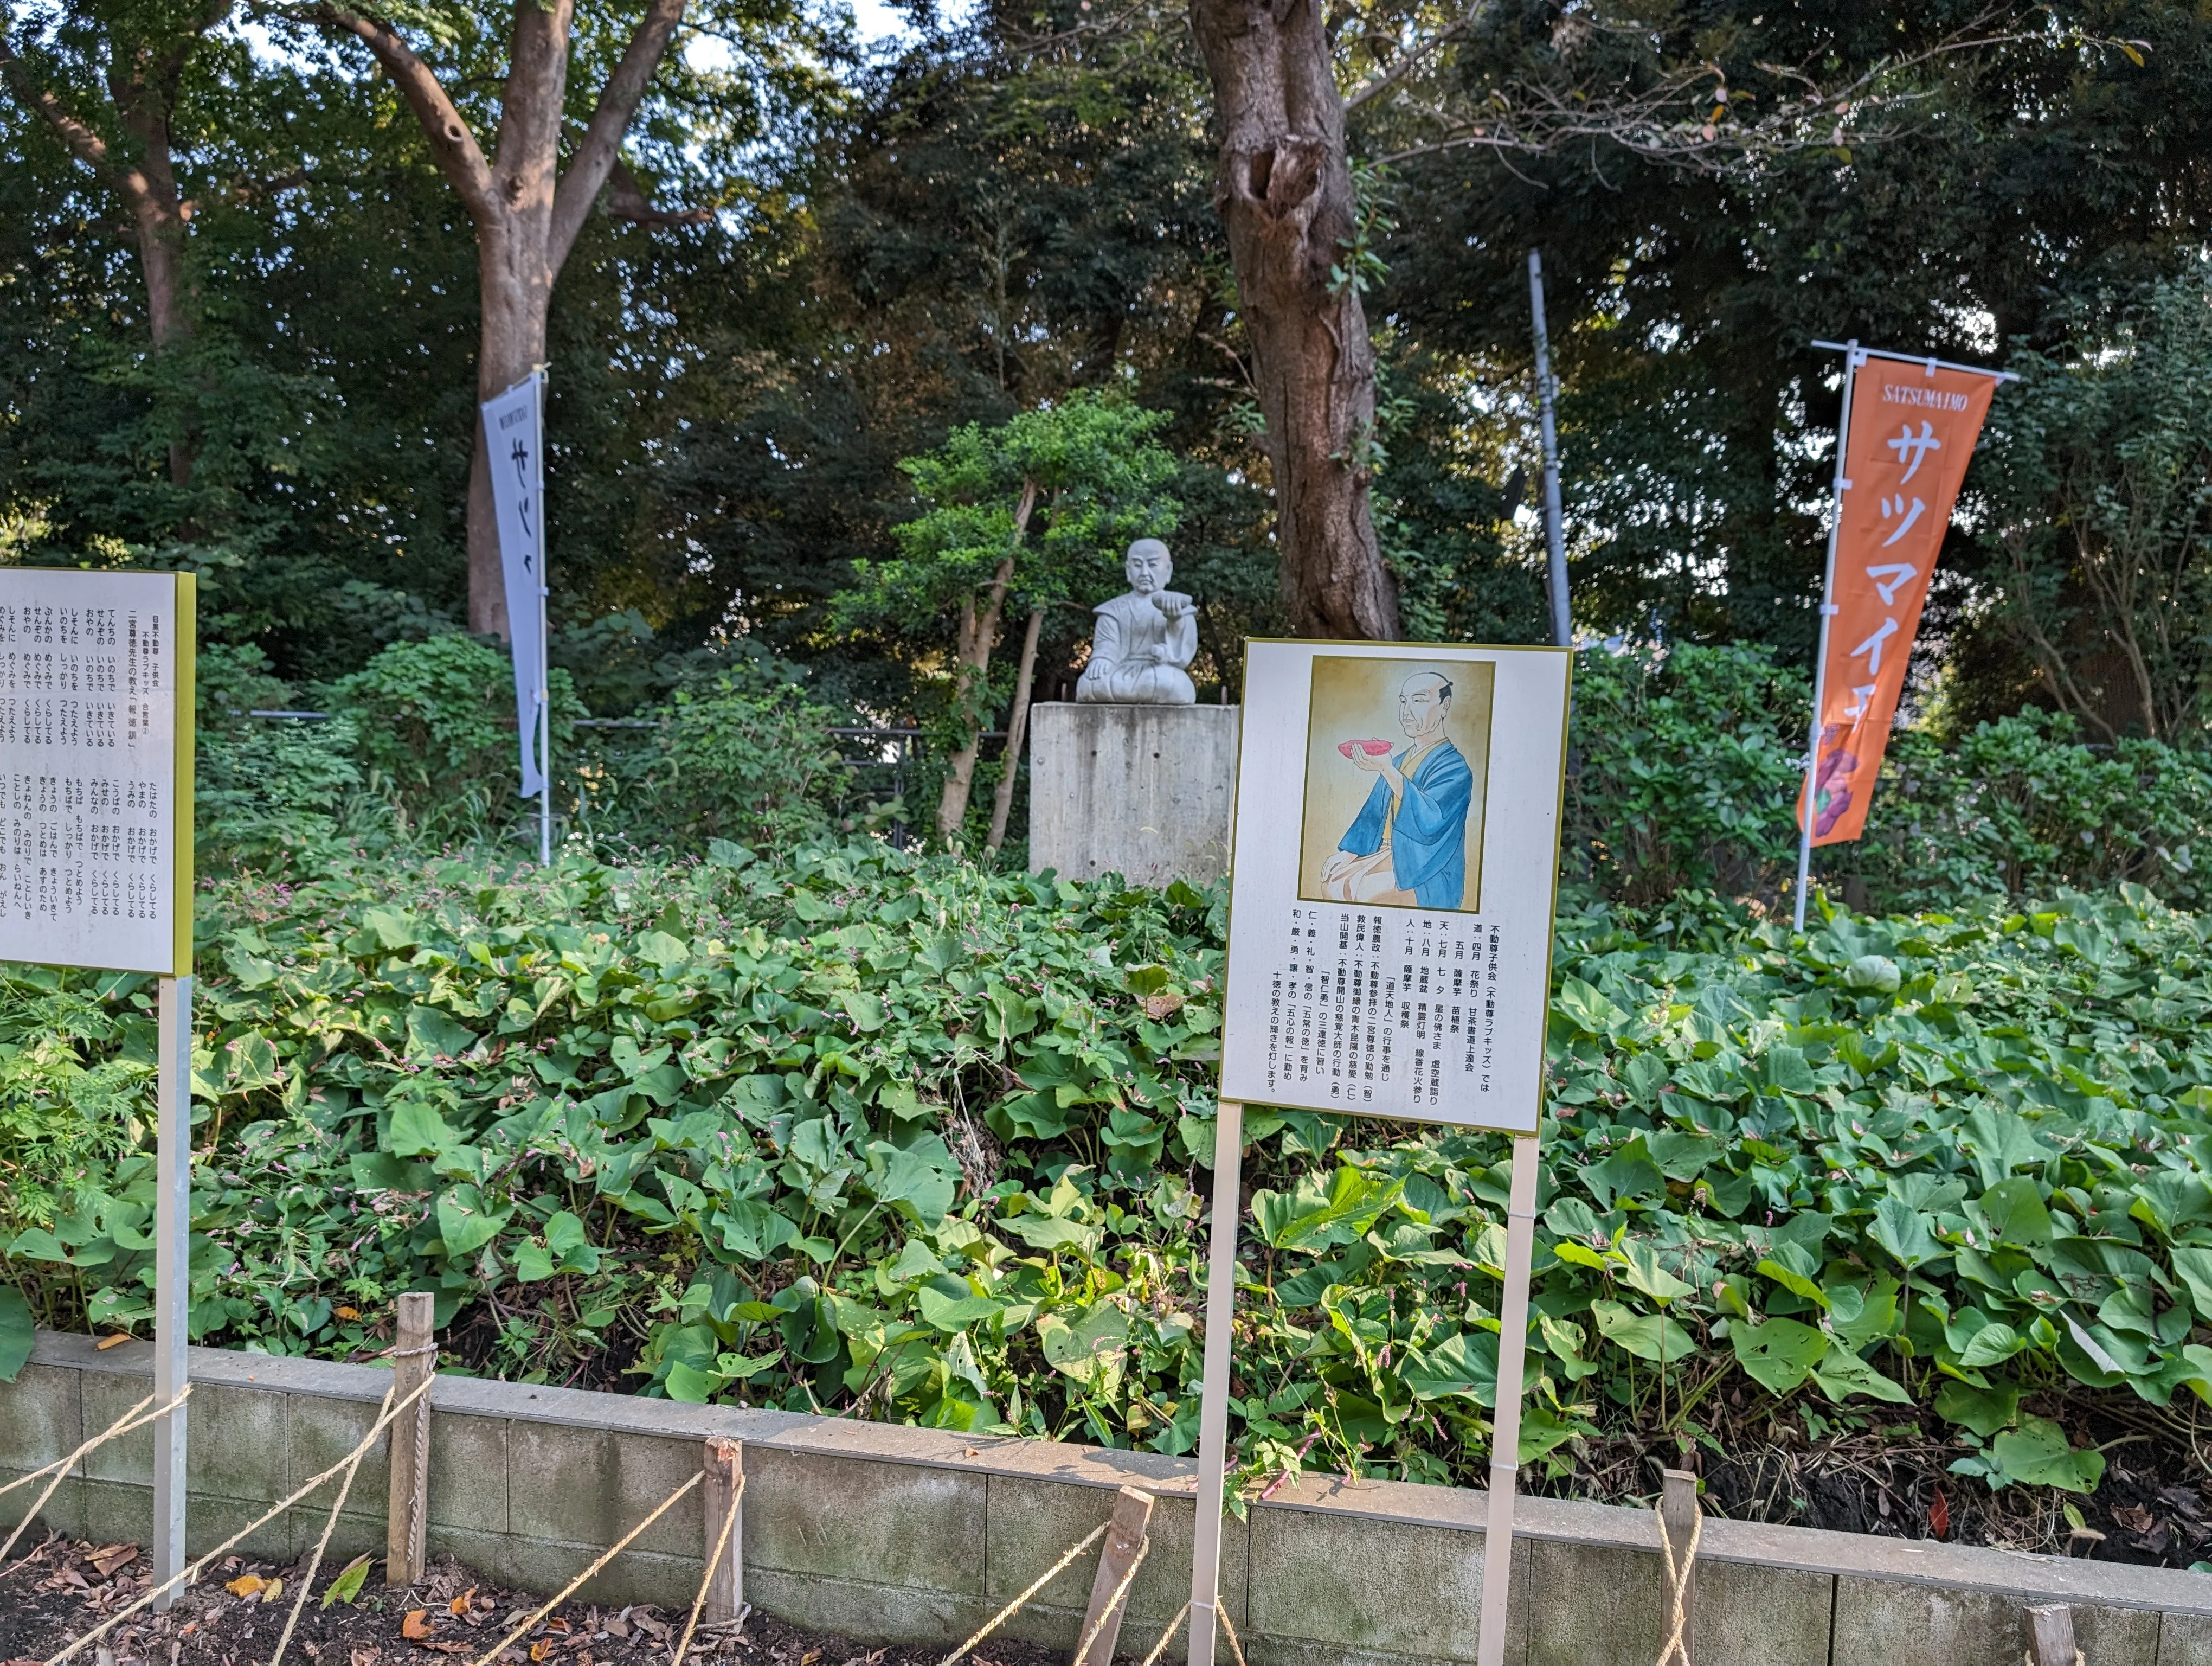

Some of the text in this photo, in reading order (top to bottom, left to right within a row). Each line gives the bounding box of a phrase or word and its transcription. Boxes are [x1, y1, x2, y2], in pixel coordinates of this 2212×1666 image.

[1882, 383, 1968, 412] SATSUMAIMO
[8, 605, 16, 642] しそんに
[34, 606, 42, 644] せんぞの
[23, 606, 31, 744] おやの めぐみで くらしてる
[34, 652, 42, 690] めぐみで
[44, 606, 53, 745] ぶんかの めぐみで くらしてる
[60, 607, 68, 745] いのちを しっかり つたえよう
[70, 607, 79, 747] しそんに いのちを つたえよう
[86, 608, 94, 747] おやの いのちで いきている
[96, 608, 105, 747] せんぞの いのちで いきている
[107, 609, 116, 747] てんちの いのちで いきている
[142, 631, 150, 695] 不動尊ラブキッズ
[8, 698, 16, 744] つたえよう
[23, 775, 32, 821] きょねんの
[49, 776, 57, 813] きょうの
[12, 774, 22, 908] ことしの みのりは らいねんへ
[23, 829, 32, 866] みのりで
[38, 776, 47, 912] きょうの つとめは あすのため
[65, 822, 73, 860] しっかり
[90, 778, 99, 917] みんなの おかげで くらしてる
[101, 779, 110, 915] みせの おかげで くらしてる
[112, 825, 121, 861] おかげで
[127, 780, 136, 918] うみの おかげで くらしてる
[138, 781, 147, 919] やまの おかげで くらしてる
[149, 781, 158, 920] たはたの おかげで くらしてる
[49, 867, 58, 921] きょういきて
[65, 869, 73, 914] つとめよう
[75, 861, 83, 906] つとめよう
[112, 870, 120, 916] くらしてる
[1401, 964, 1413, 992] 薩摩芋
[1418, 965, 1430, 994] 地蔵盆
[1450, 941, 1465, 1034] 五月 薩摩芋 苗植祭
[1469, 970, 1481, 998] 花祭り
[1267, 971, 1283, 1092] 十徳の教えの輝きを灯します。
[1316, 971, 1330, 1074] 「智仁勇」の三達徳に習い
[1380, 977, 1397, 1082] 「道天地人」の行事を通じ
[1400, 1001, 1411, 1029] 収穫祭
[1416, 1002, 1427, 1040] 精霊灯明
[1432, 1004, 1444, 1050] 星の佛さま
[1480, 925, 1500, 1092] 不動尊子供会（不動尊ラブキッズ）では
[1464, 1007, 1478, 1073] 甘茶書道上達会
[1413, 1048, 1424, 1104] 線香花火参り
